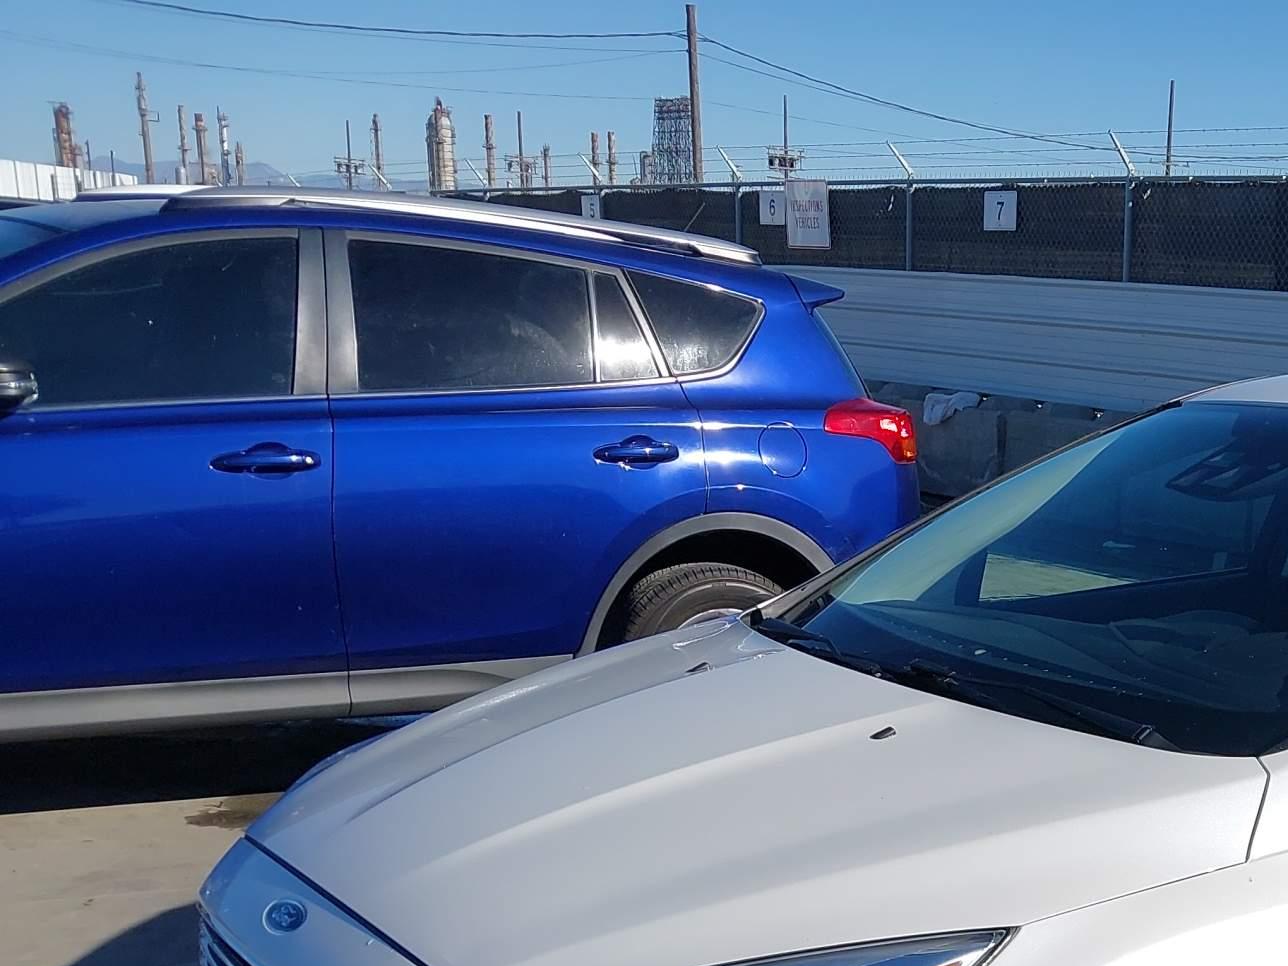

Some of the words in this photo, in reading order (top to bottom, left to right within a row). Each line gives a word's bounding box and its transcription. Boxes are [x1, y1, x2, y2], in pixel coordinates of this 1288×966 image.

[589, 203, 595, 218] 5
[769, 199, 776, 217] 6
[996, 201, 1005, 221] 7
[794, 215, 820, 230] VEHICLES
